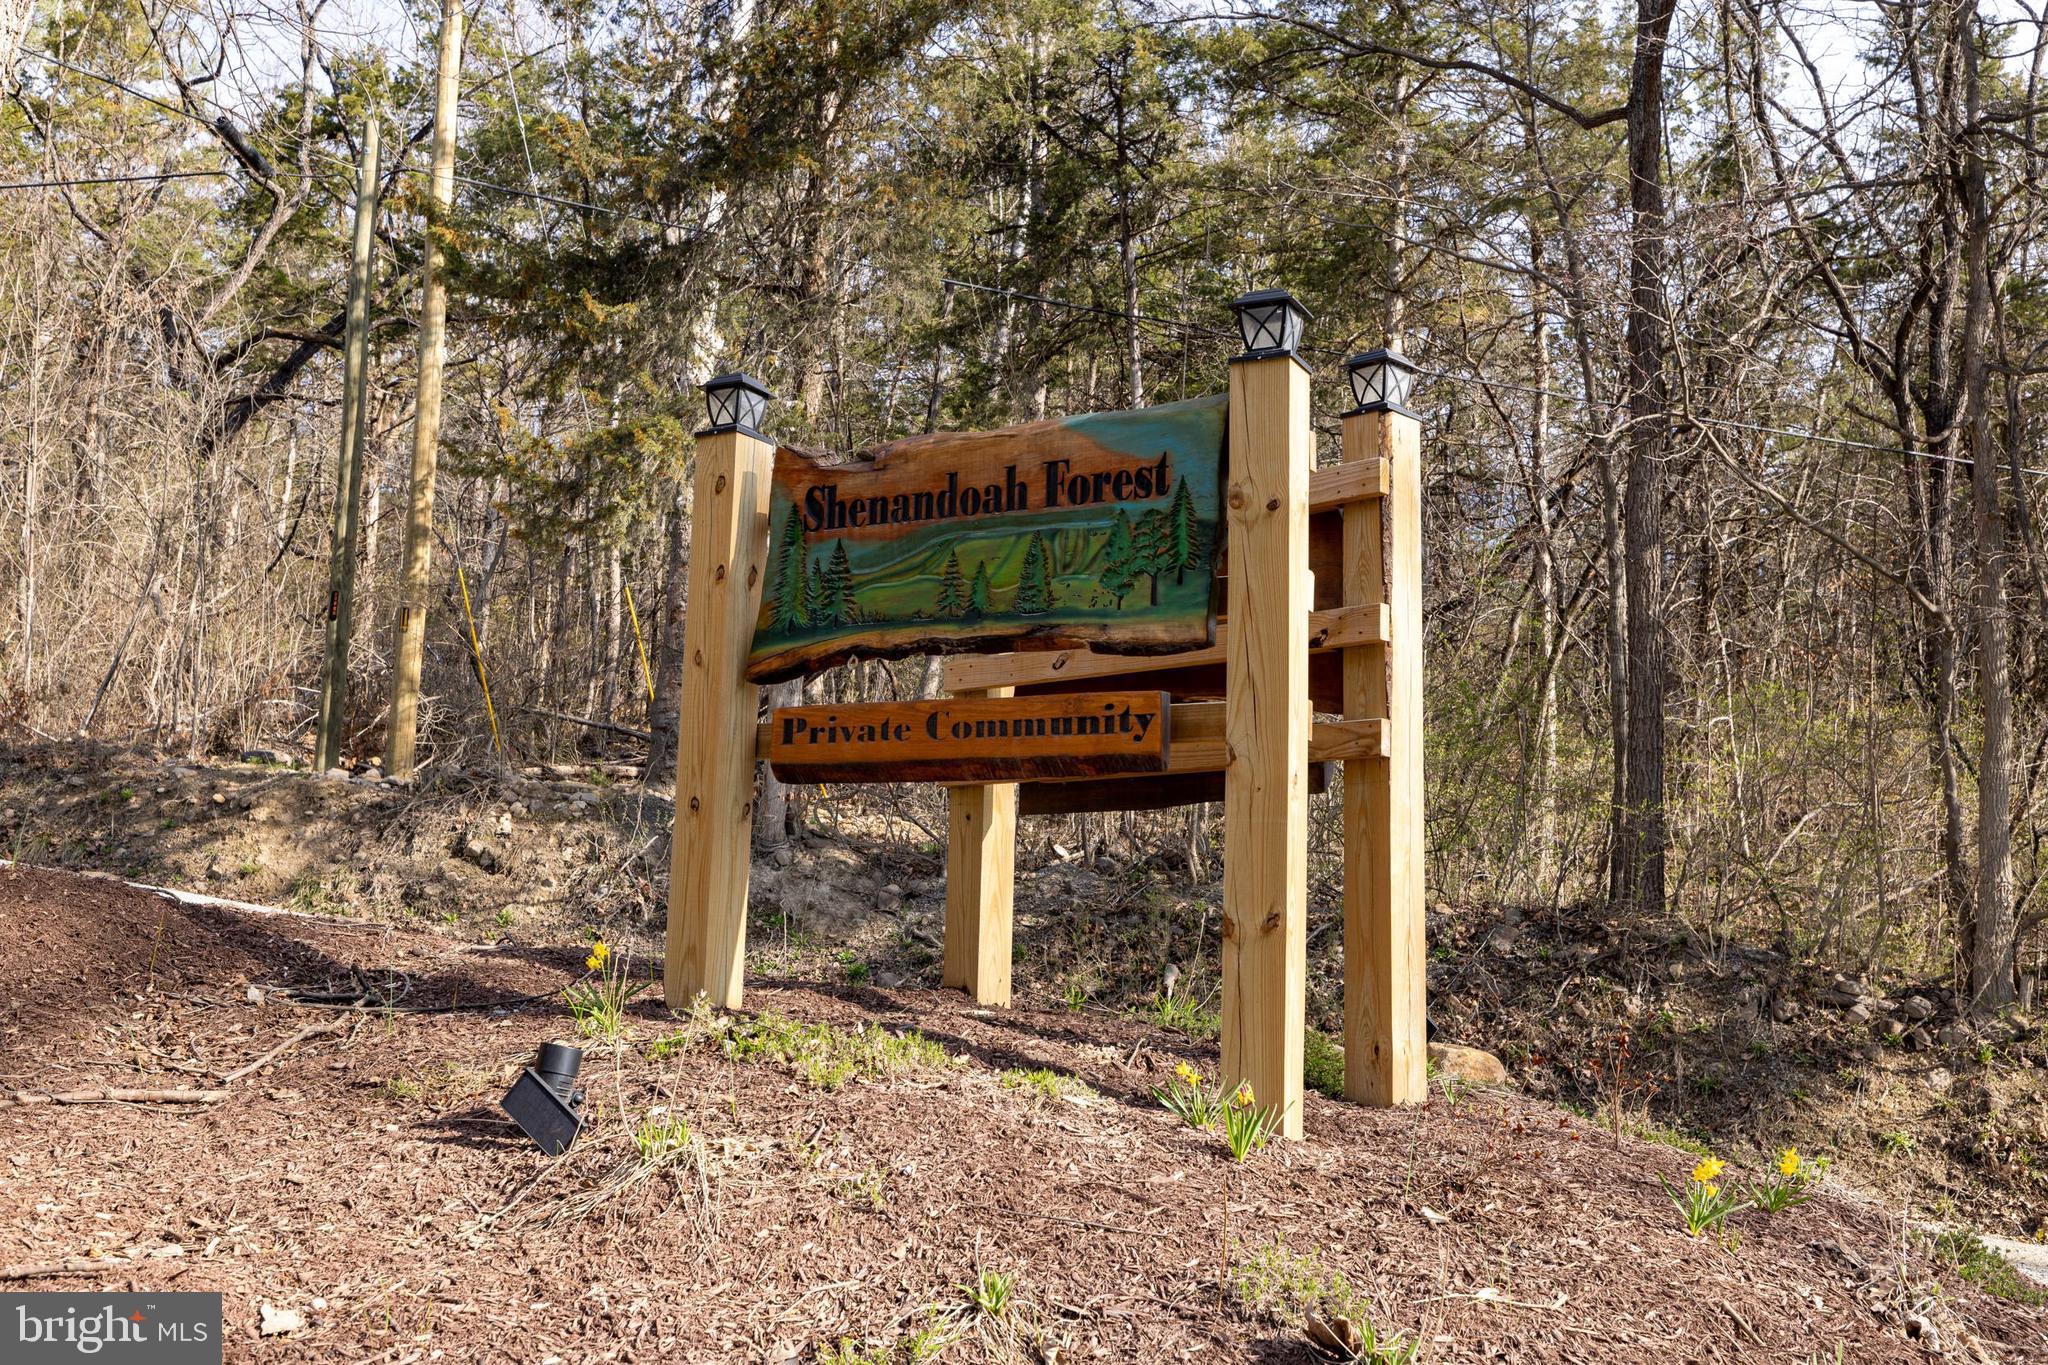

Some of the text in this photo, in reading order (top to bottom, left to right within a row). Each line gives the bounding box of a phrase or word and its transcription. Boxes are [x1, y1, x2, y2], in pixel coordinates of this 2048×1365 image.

[802, 451, 1171, 533] Shenandoah Forest
[781, 703, 1156, 745] Private Community
